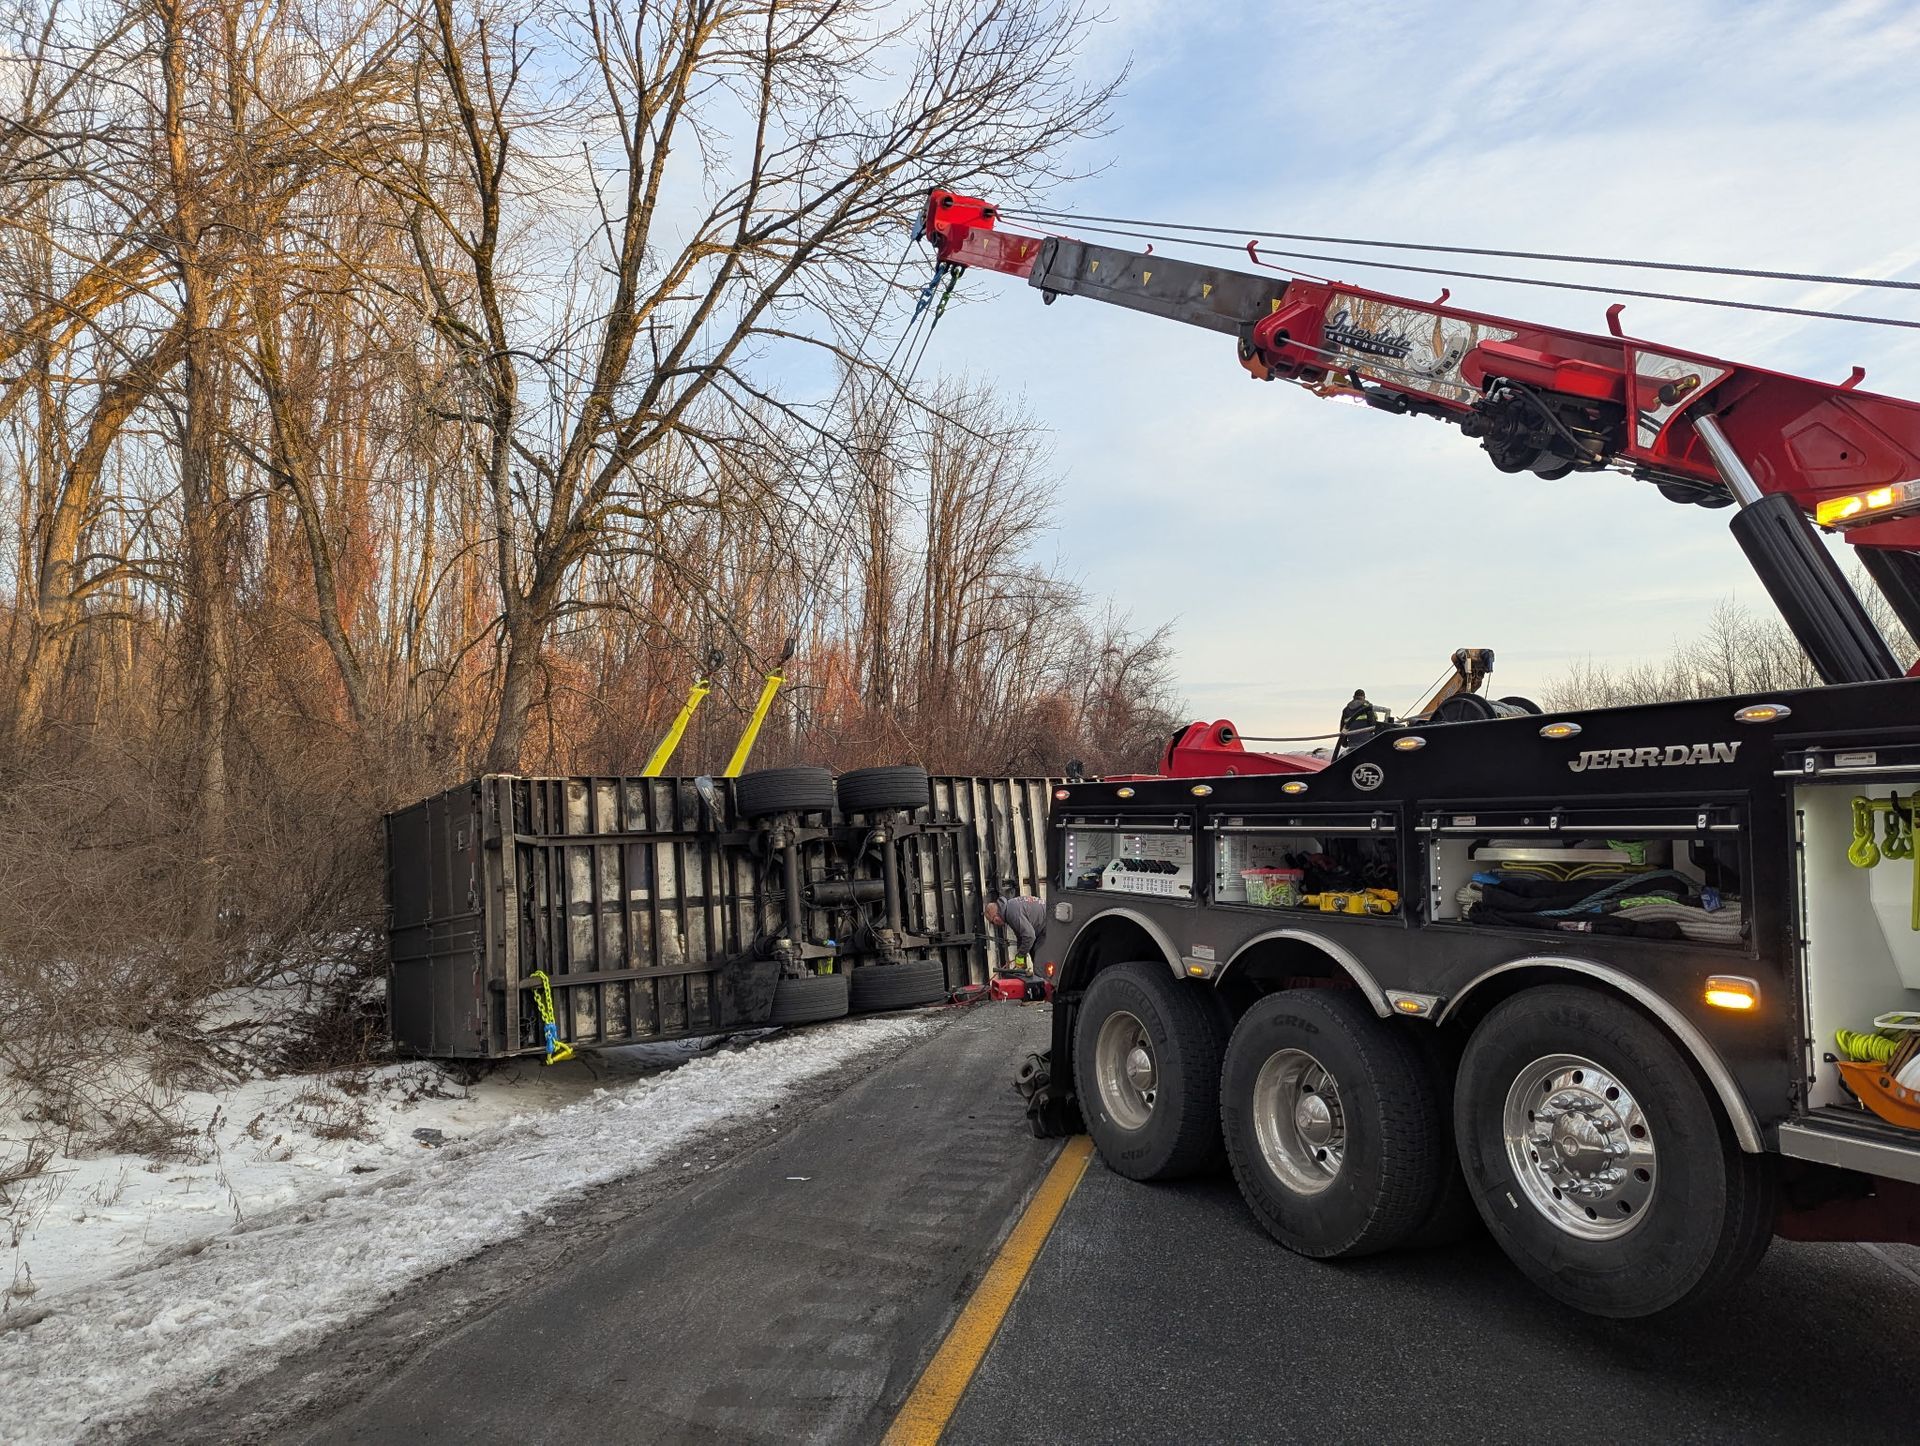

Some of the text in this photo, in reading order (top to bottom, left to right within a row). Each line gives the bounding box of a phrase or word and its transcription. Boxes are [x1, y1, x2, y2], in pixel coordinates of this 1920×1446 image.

[1324, 310, 1412, 349] Interstate
[1327, 333, 1407, 358] NORTHEAST
[1568, 741, 1742, 772] JERR-DAN
[1355, 768, 1379, 786] JFB
[1274, 1014, 1320, 1034] GRIP
